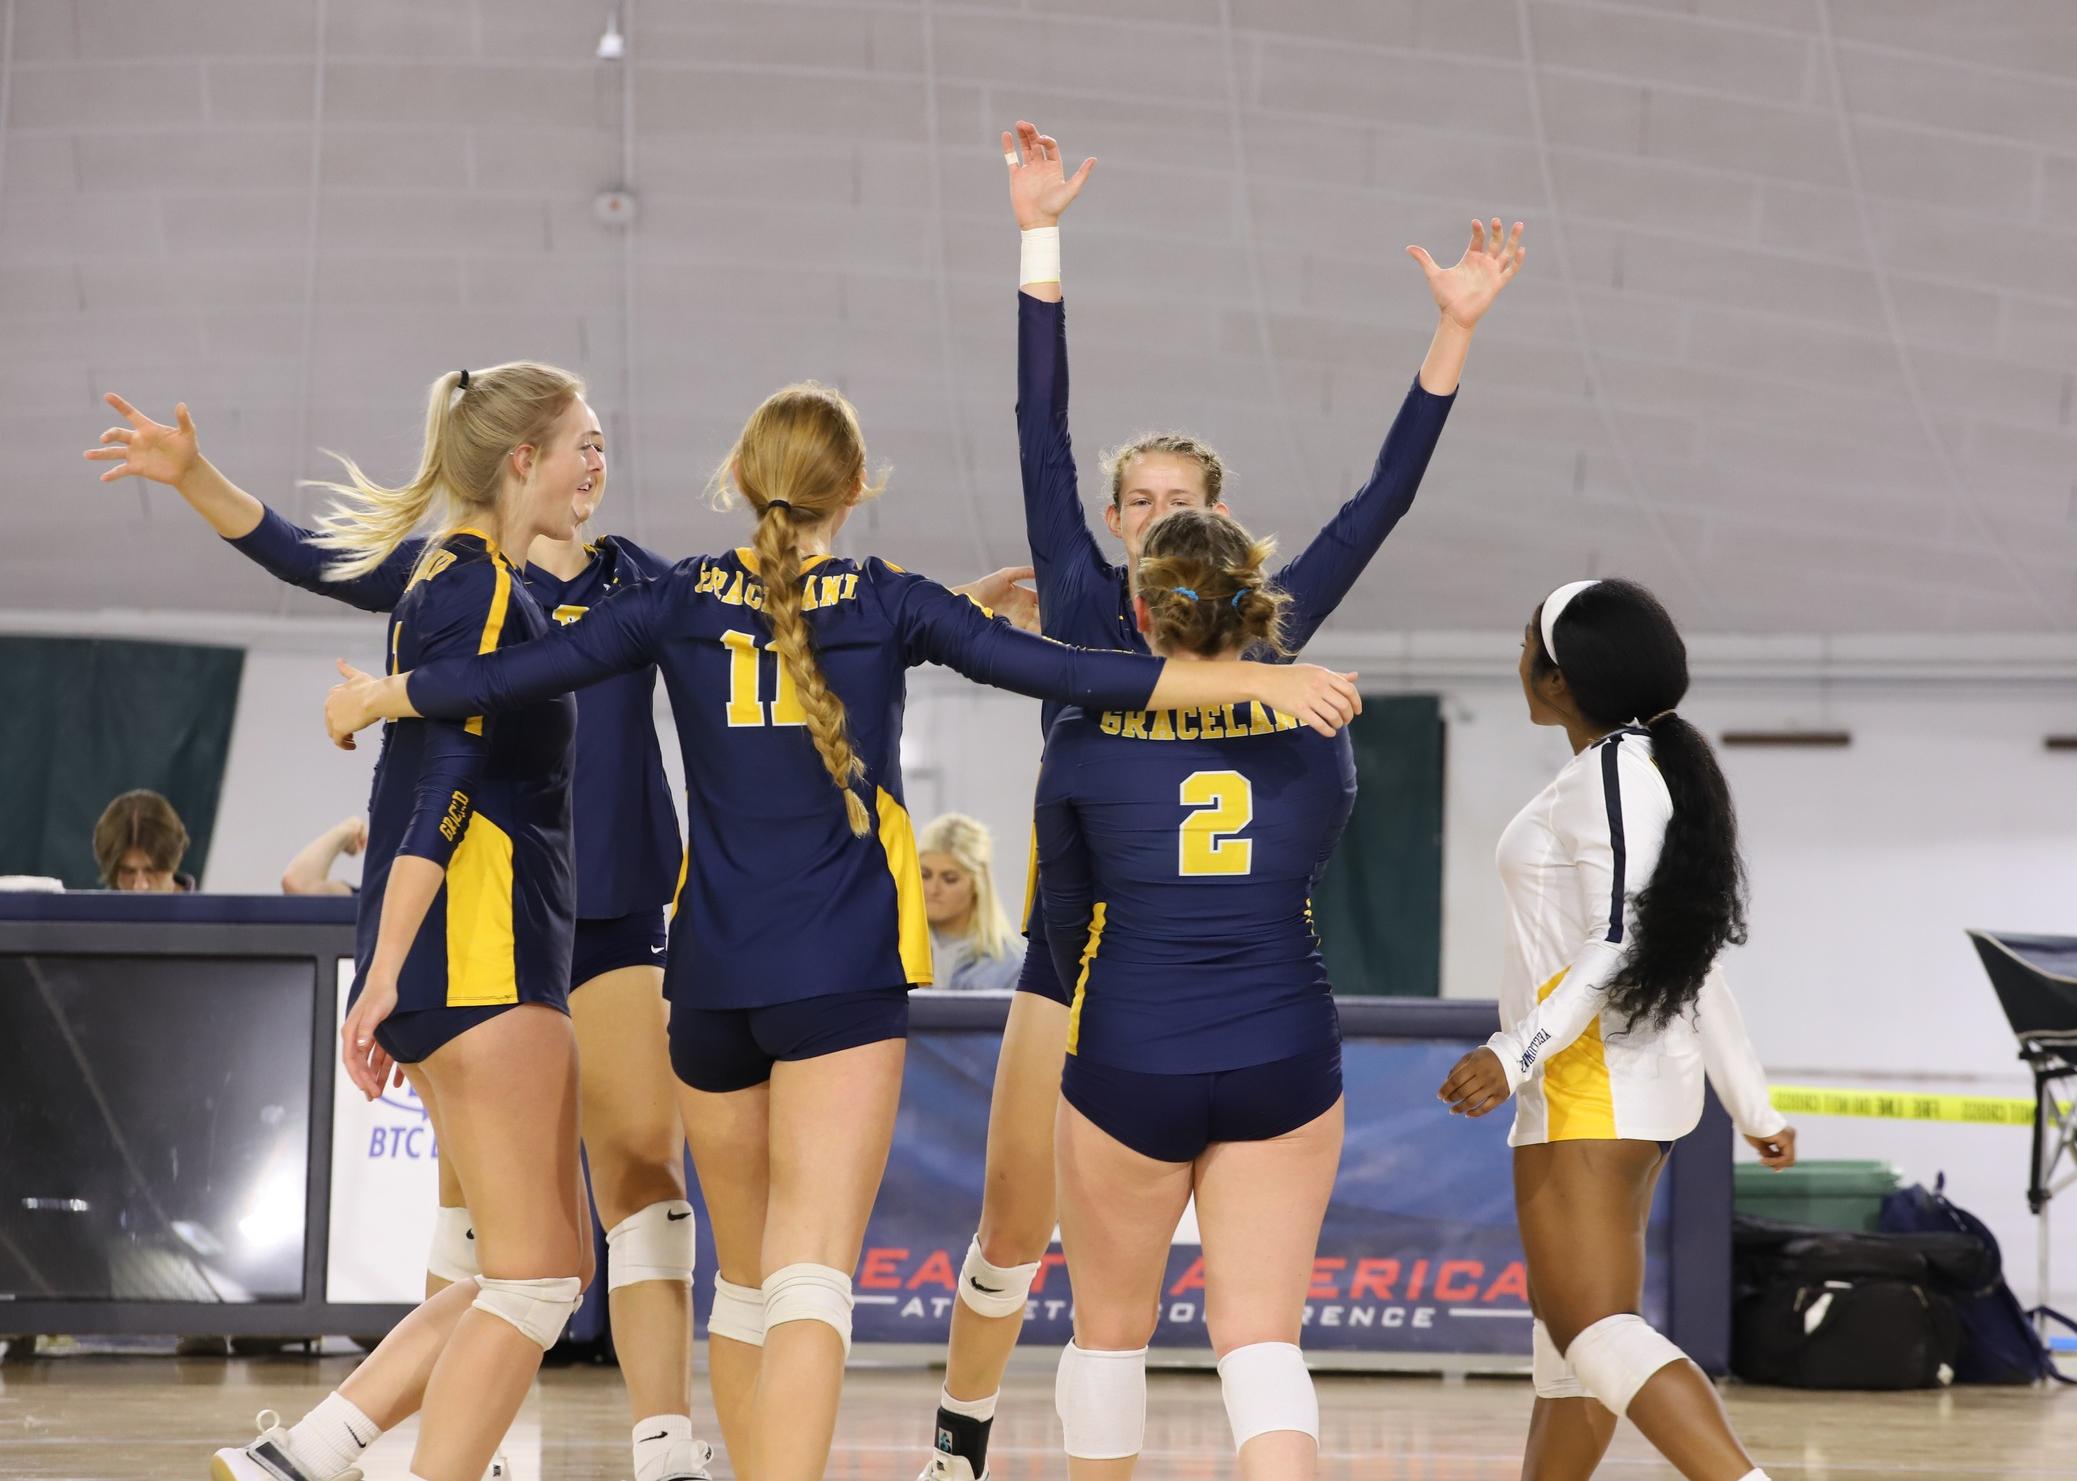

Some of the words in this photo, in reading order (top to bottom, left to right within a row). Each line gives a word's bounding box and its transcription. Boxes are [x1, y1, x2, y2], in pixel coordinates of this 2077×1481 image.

[1099, 699, 1310, 741] GRACELAN
[1178, 770, 1253, 877] 2
[368, 1126, 425, 1159] BTC
[1168, 1255, 1529, 1303] AERICA
